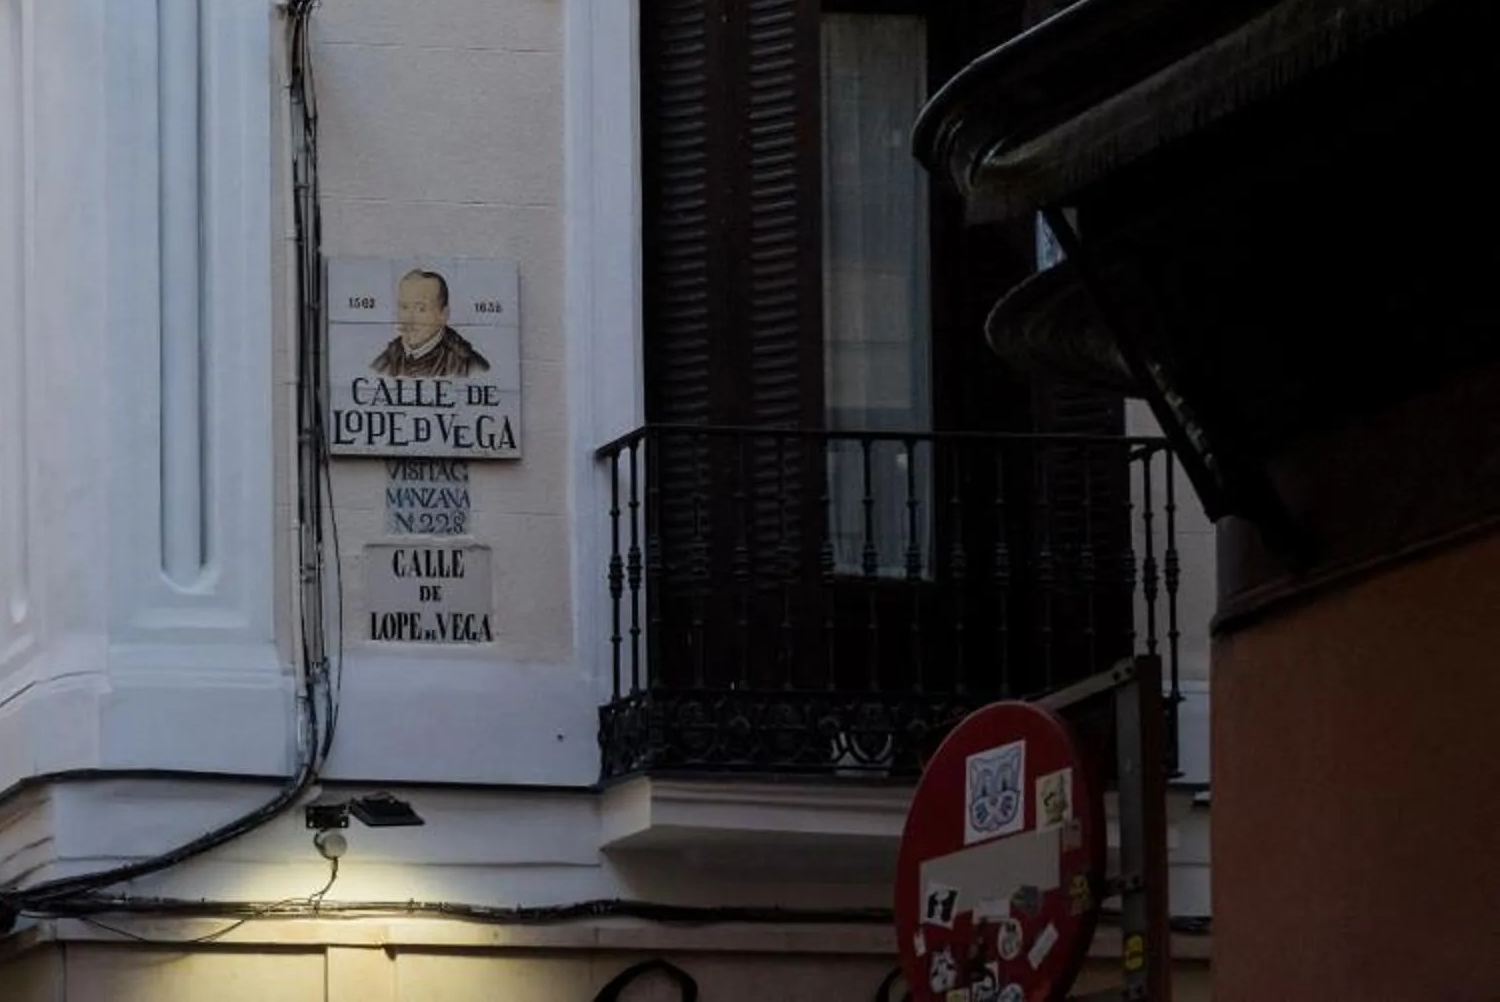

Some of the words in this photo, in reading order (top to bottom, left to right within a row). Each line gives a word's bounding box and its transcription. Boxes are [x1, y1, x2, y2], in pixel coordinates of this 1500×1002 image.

[352, 377, 456, 408] CALLE
[466, 384, 500, 407] DE
[332, 409, 409, 446] LOPE
[434, 413, 517, 450] VEGA
[386, 488, 471, 509] MANZANA
[392, 549, 465, 579] CALLE
[419, 585, 442, 602] DE
[370, 611, 421, 641] LOPE
[434, 612, 492, 642] VEGA
